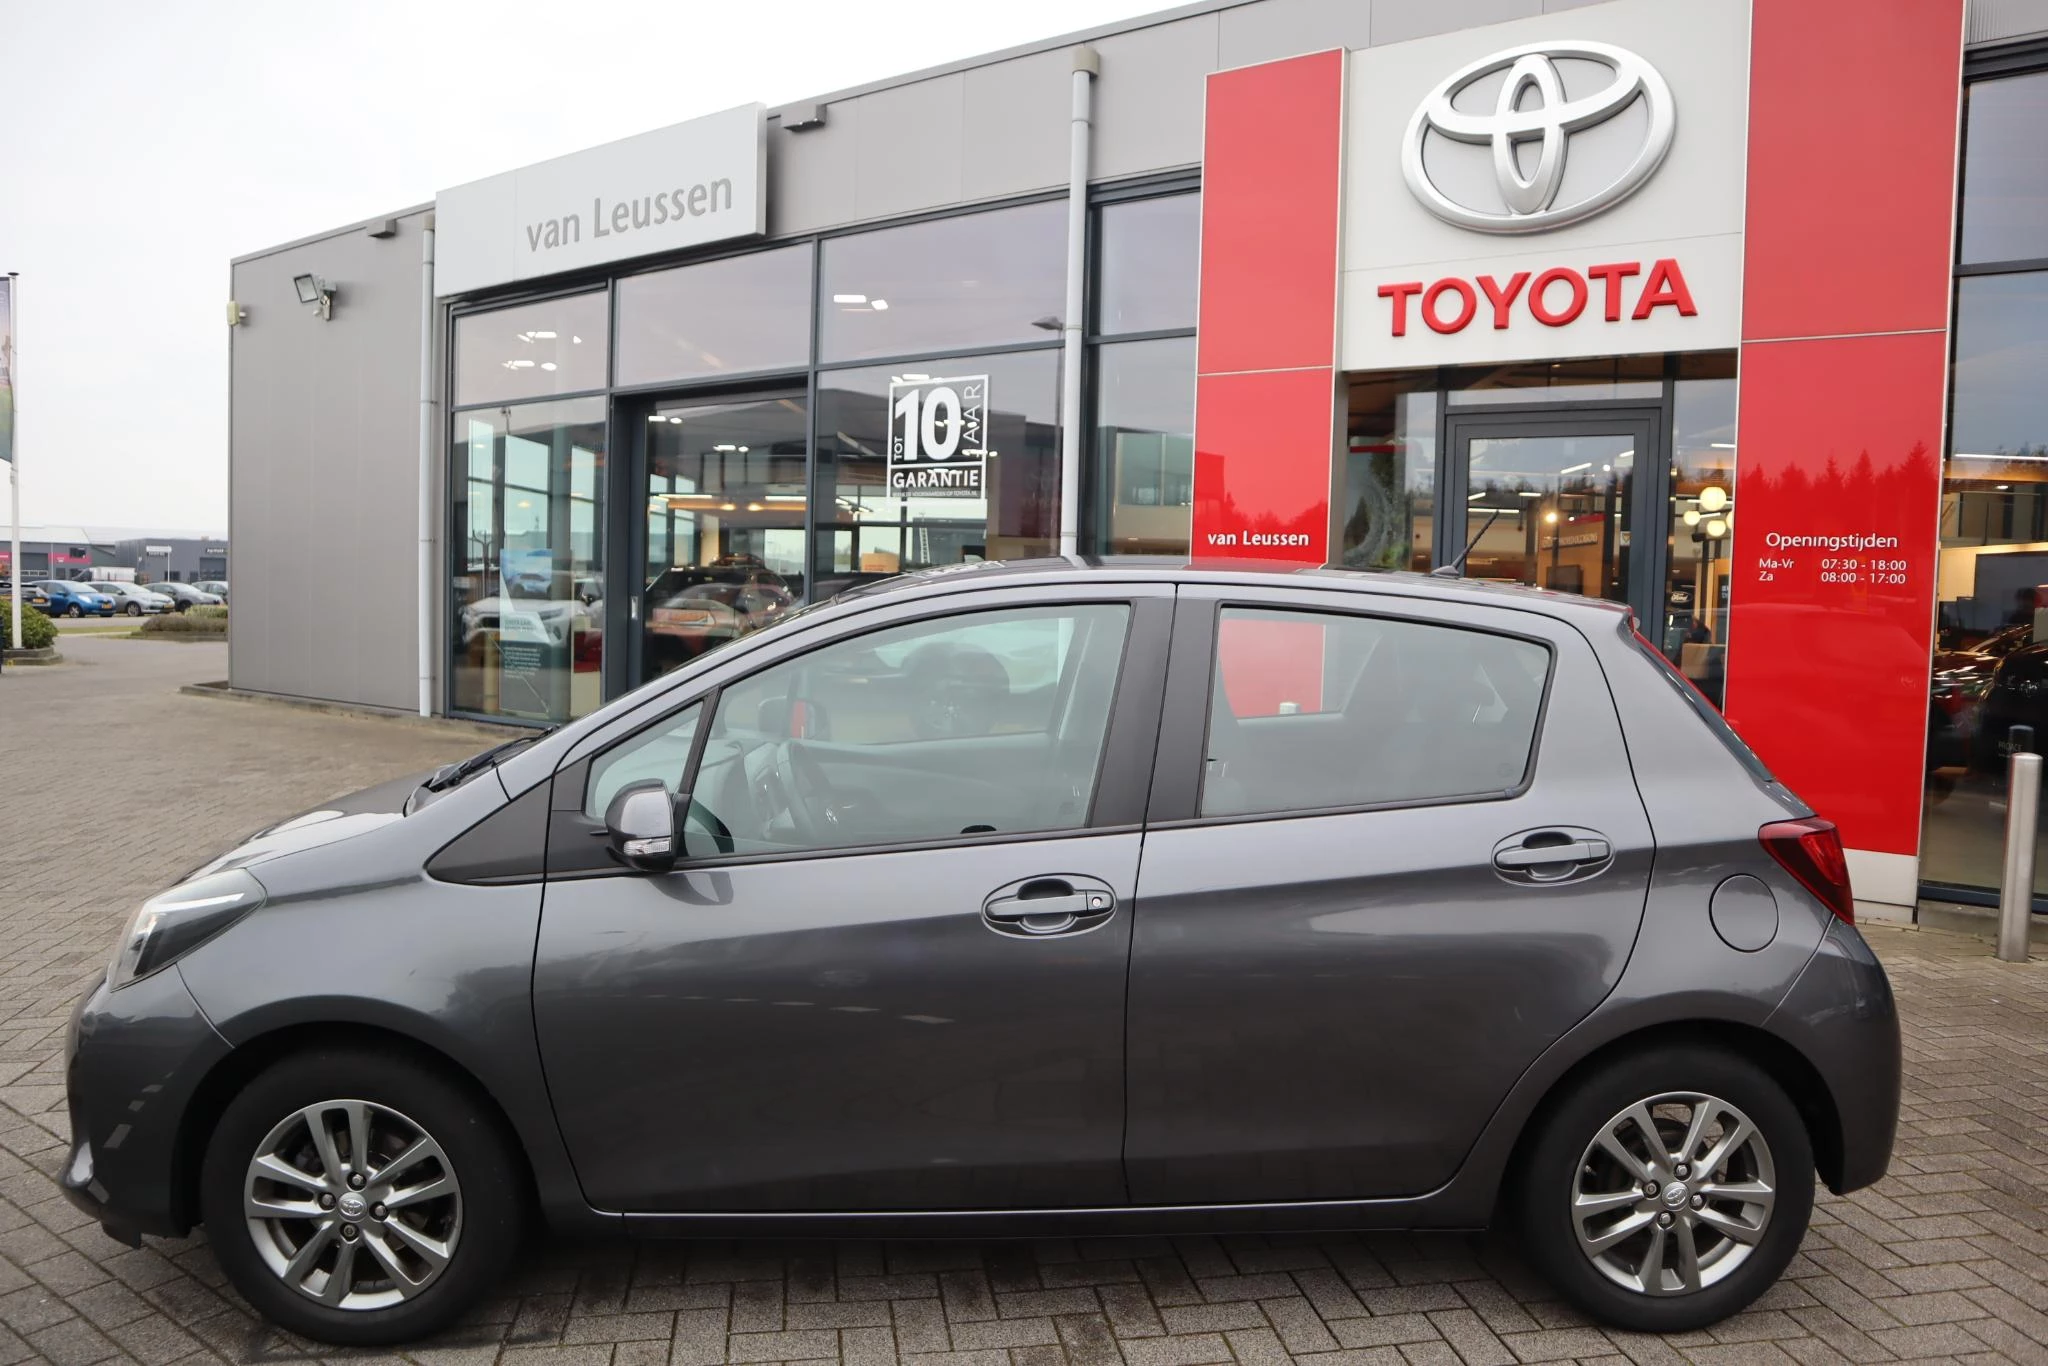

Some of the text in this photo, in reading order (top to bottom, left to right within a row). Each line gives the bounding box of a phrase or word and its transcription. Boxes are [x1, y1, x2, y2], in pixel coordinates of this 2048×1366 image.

[527, 177, 732, 252] van Leussen
[1378, 258, 1698, 337] TOYOTA
[895, 386, 961, 460] 10
[893, 436, 903, 461] TOT
[893, 470, 979, 488] GARANTIE
[1207, 530, 1309, 546] van Leussen
[1766, 532, 1898, 551] Openingstijden
[1759, 558, 1794, 569] Ma-Vr
[1821, 558, 1857, 570] 07:30
[1870, 559, 1907, 571] 18:00
[1759, 571, 1774, 582] Za
[1821, 571, 1857, 583] 08:00
[1869, 573, 1906, 584] 17:00
